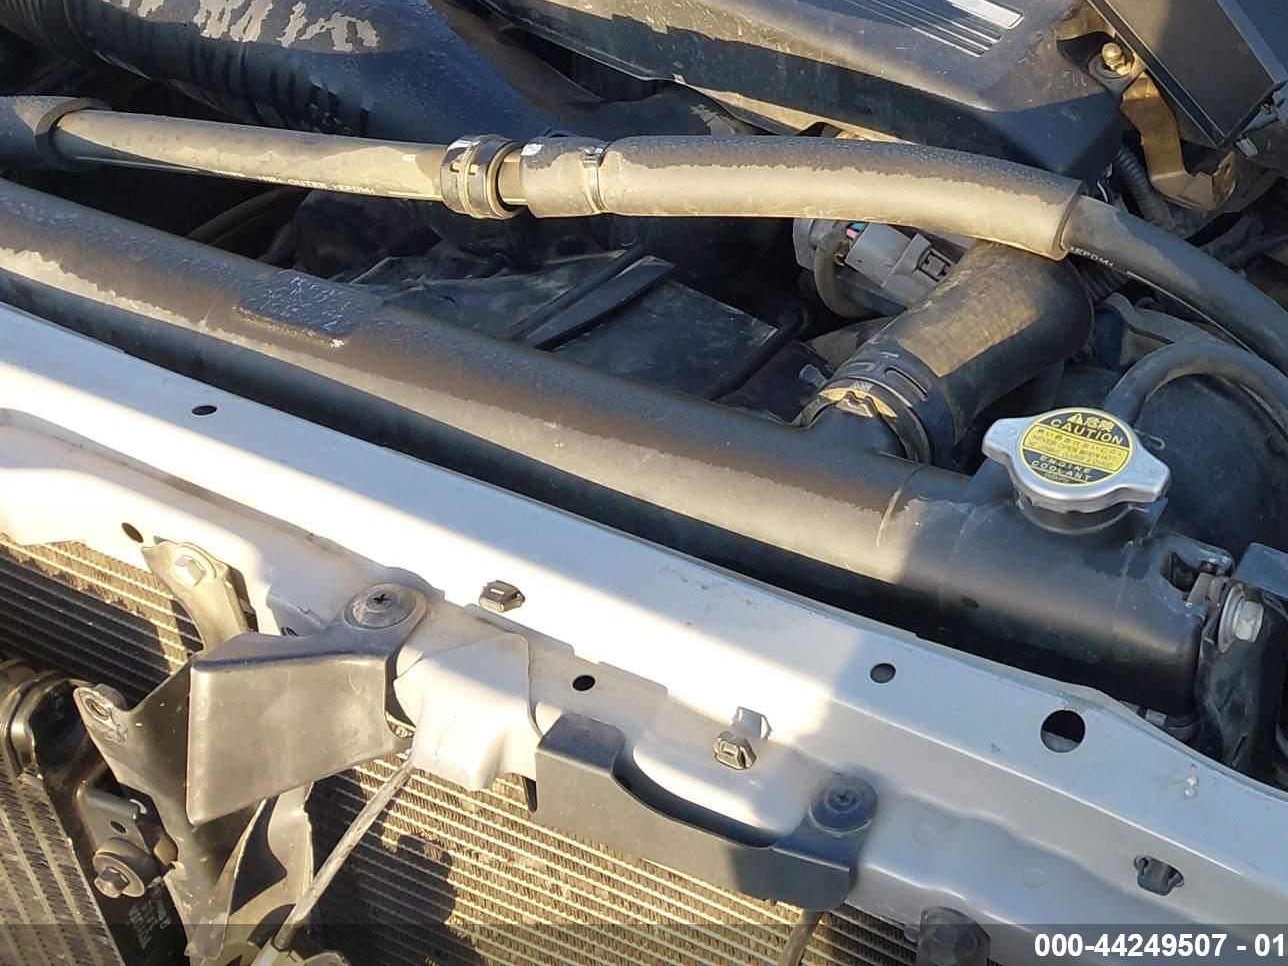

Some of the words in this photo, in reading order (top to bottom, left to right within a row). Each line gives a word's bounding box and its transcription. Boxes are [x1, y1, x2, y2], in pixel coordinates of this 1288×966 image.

[1050, 419, 1124, 445] CAUTION
[1031, 460, 1091, 481] COOLANT
[1040, 455, 1091, 473] ENGINE
